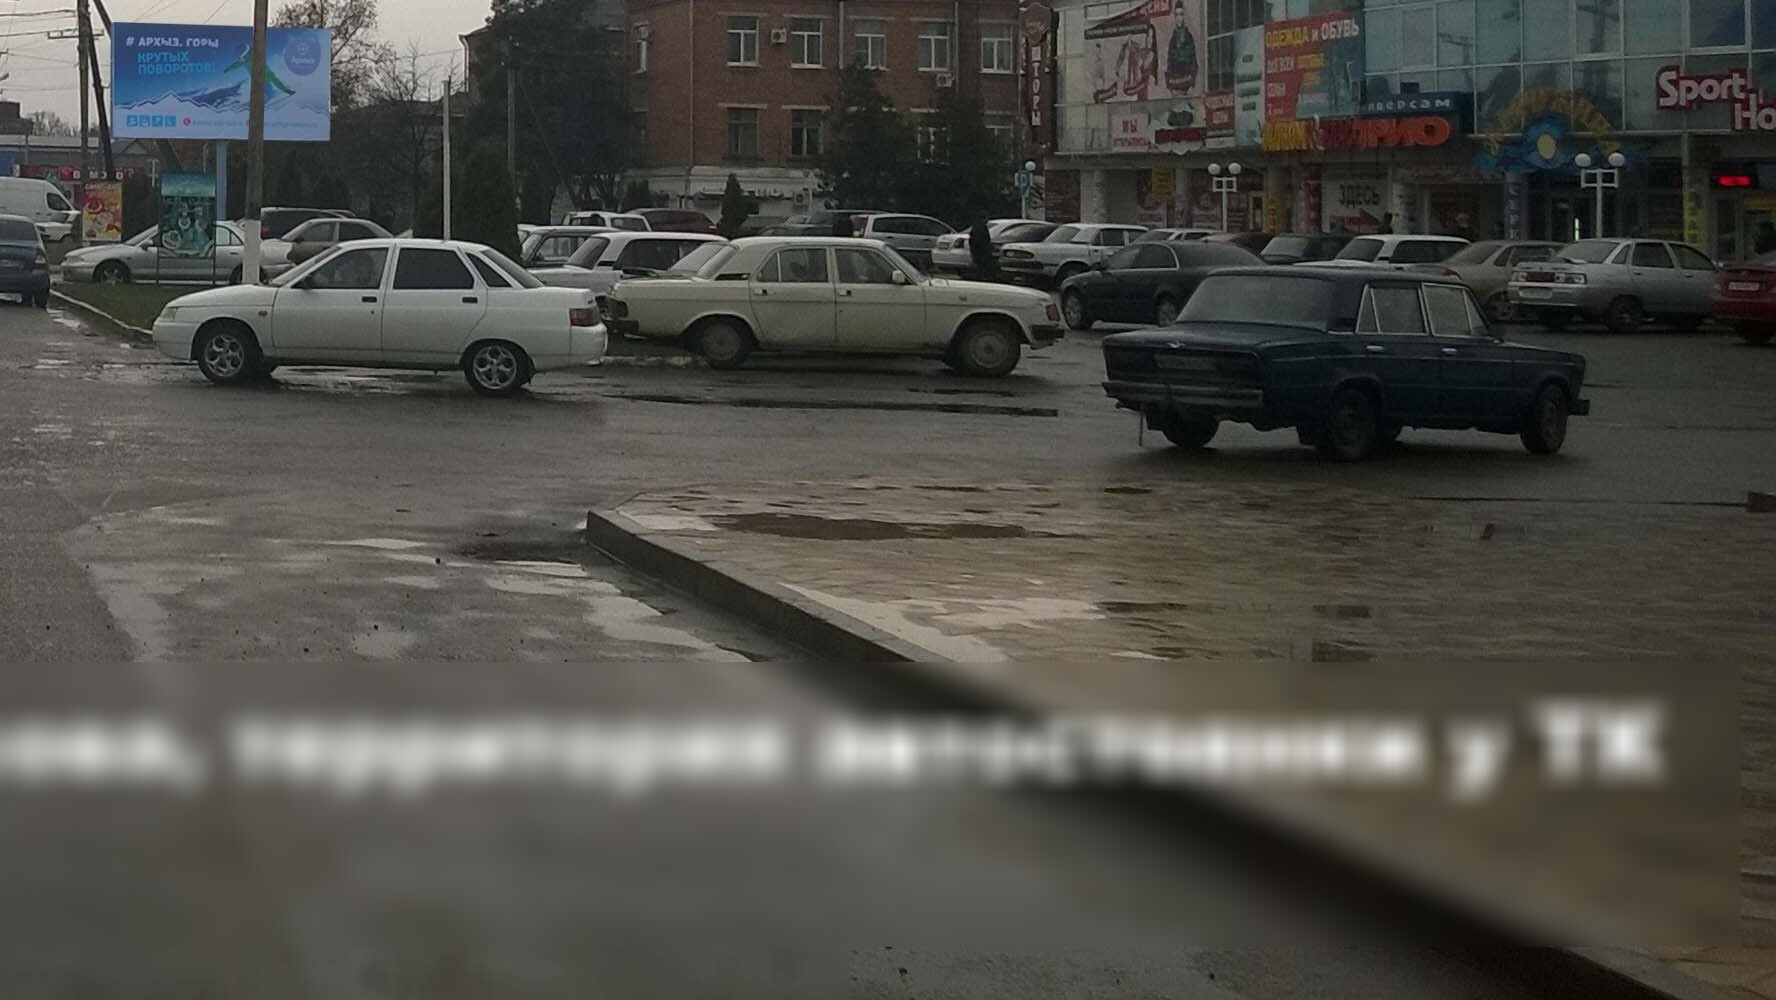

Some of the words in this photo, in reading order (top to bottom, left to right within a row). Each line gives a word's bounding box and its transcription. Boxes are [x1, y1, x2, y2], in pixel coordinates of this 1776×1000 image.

[186, 38, 220, 49] ГОРЫ
[1265, 27, 1308, 50] ОДЕЖДА
[1321, 19, 1360, 41] ОБУВЬ
[137, 51, 191, 64] КРУТЫХ
[1658, 70, 1745, 108] Sport
